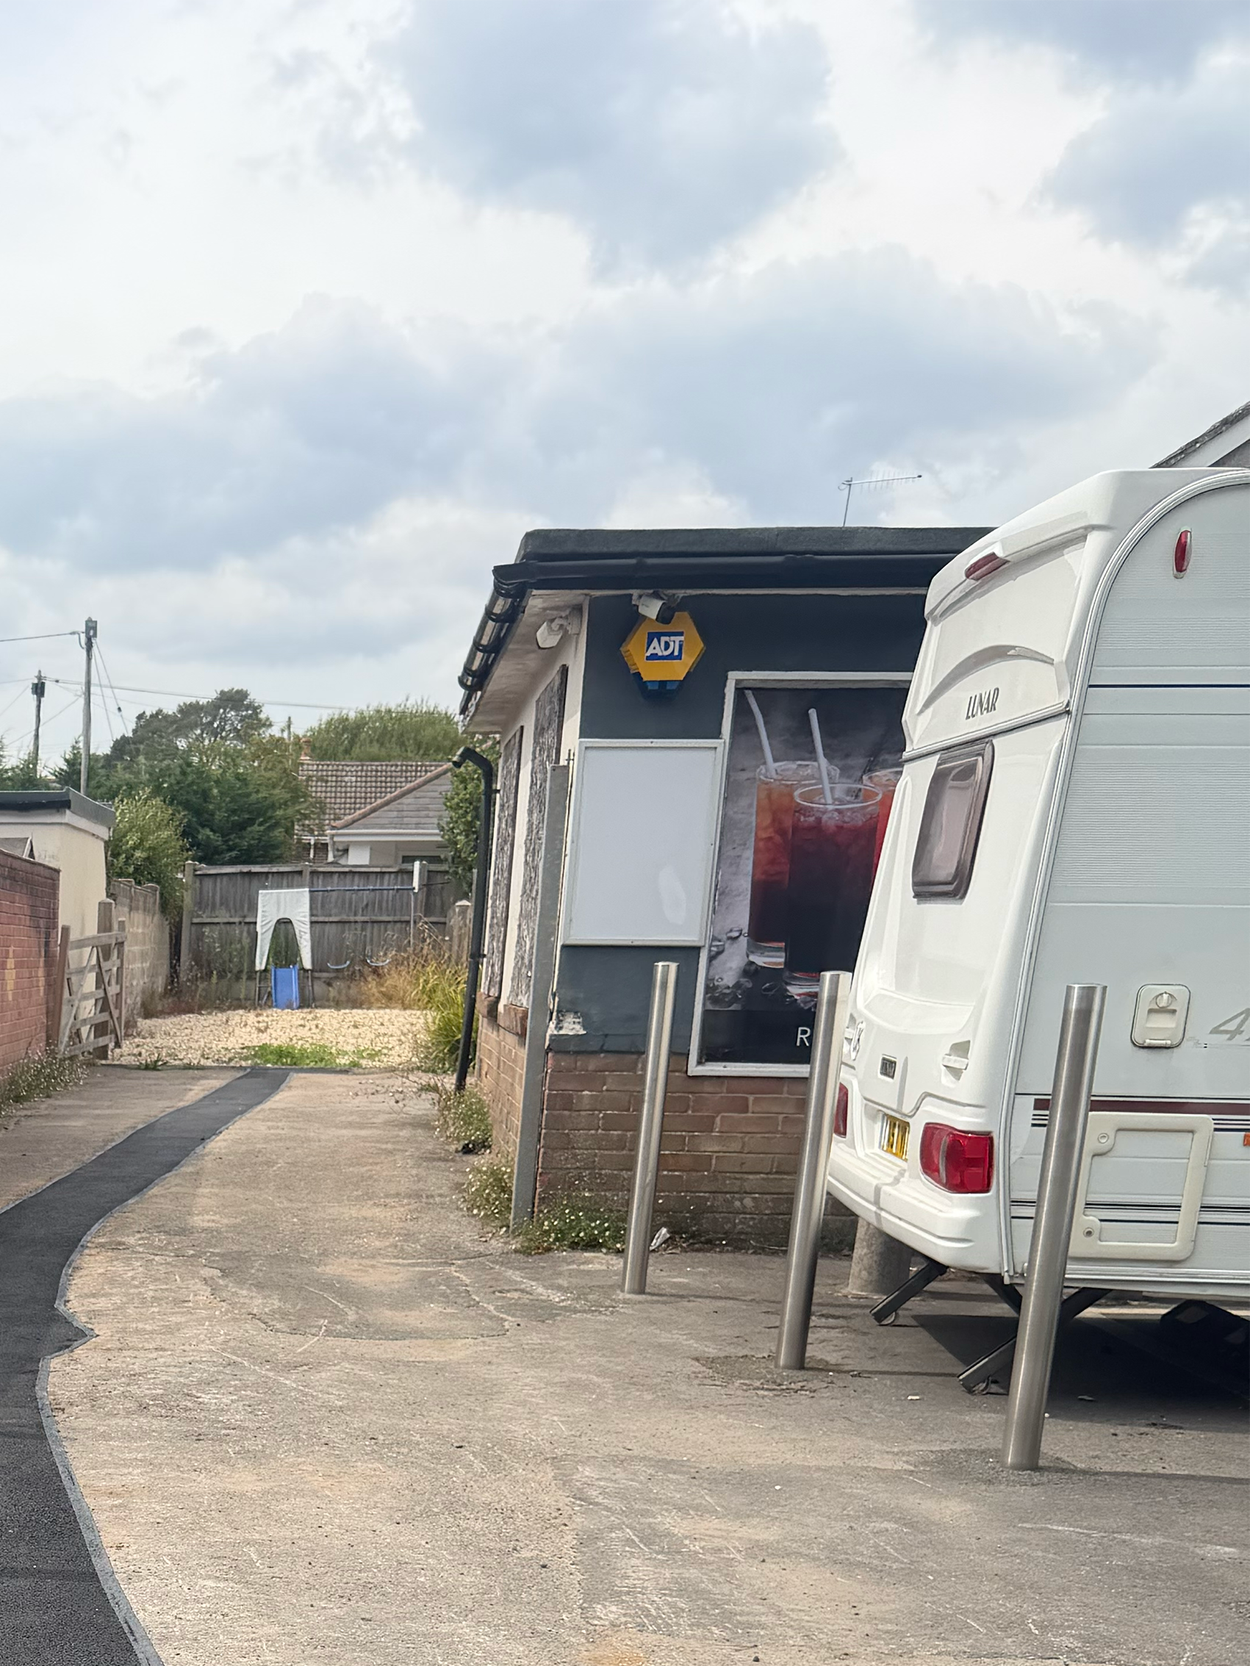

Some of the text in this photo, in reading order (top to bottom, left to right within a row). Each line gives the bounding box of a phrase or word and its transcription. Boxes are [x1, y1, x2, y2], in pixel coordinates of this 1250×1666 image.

[646, 636, 685, 656] ADT
[965, 687, 999, 720] LUNAR
[1209, 1007, 1250, 1041] 4
